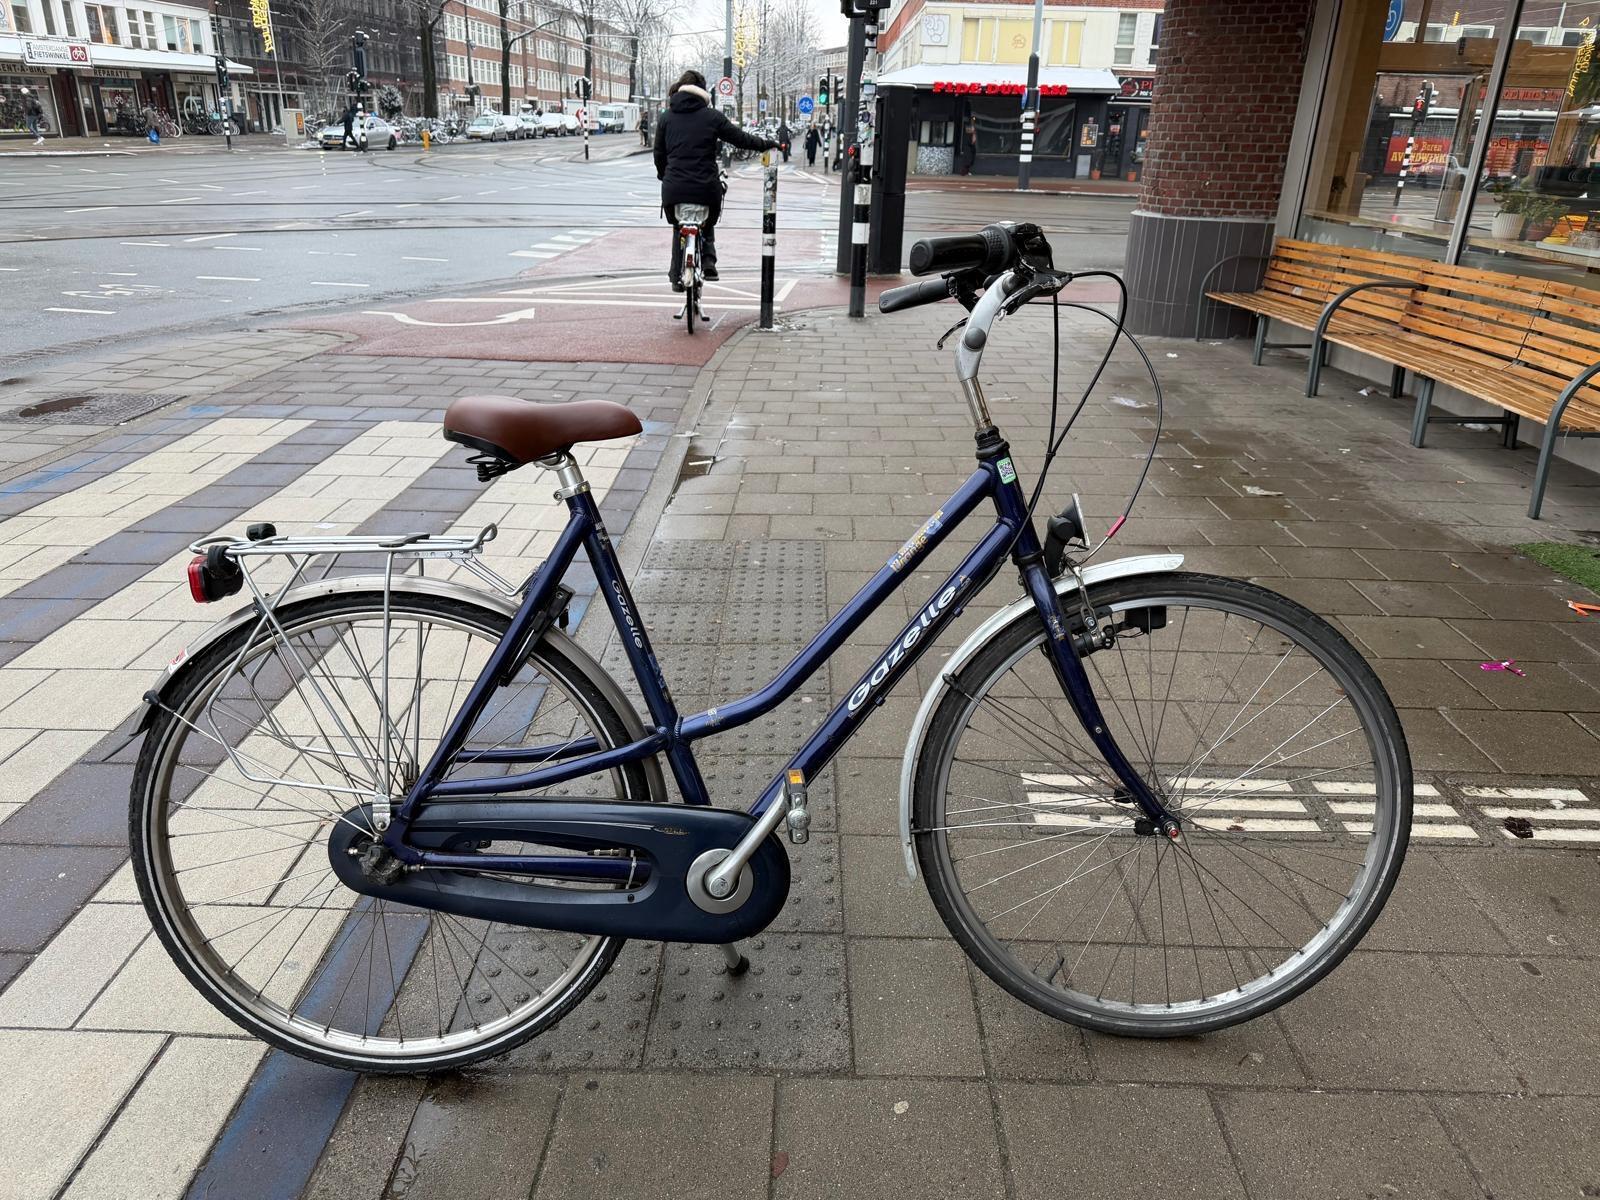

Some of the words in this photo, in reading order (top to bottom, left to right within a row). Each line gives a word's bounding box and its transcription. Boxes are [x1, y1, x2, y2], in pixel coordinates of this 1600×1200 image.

[32, 44, 68, 53] AMSTERDAMSE
[33, 51, 70, 60] FIETSWINKEL
[94, 69, 130, 79] REPARATIE
[722, 83, 731, 91] 30
[933, 81, 982, 94] PIDE
[985, 80, 1068, 96] DÜNASI
[611, 579, 643, 649] Gazelle
[847, 586, 956, 711] Gazelle
